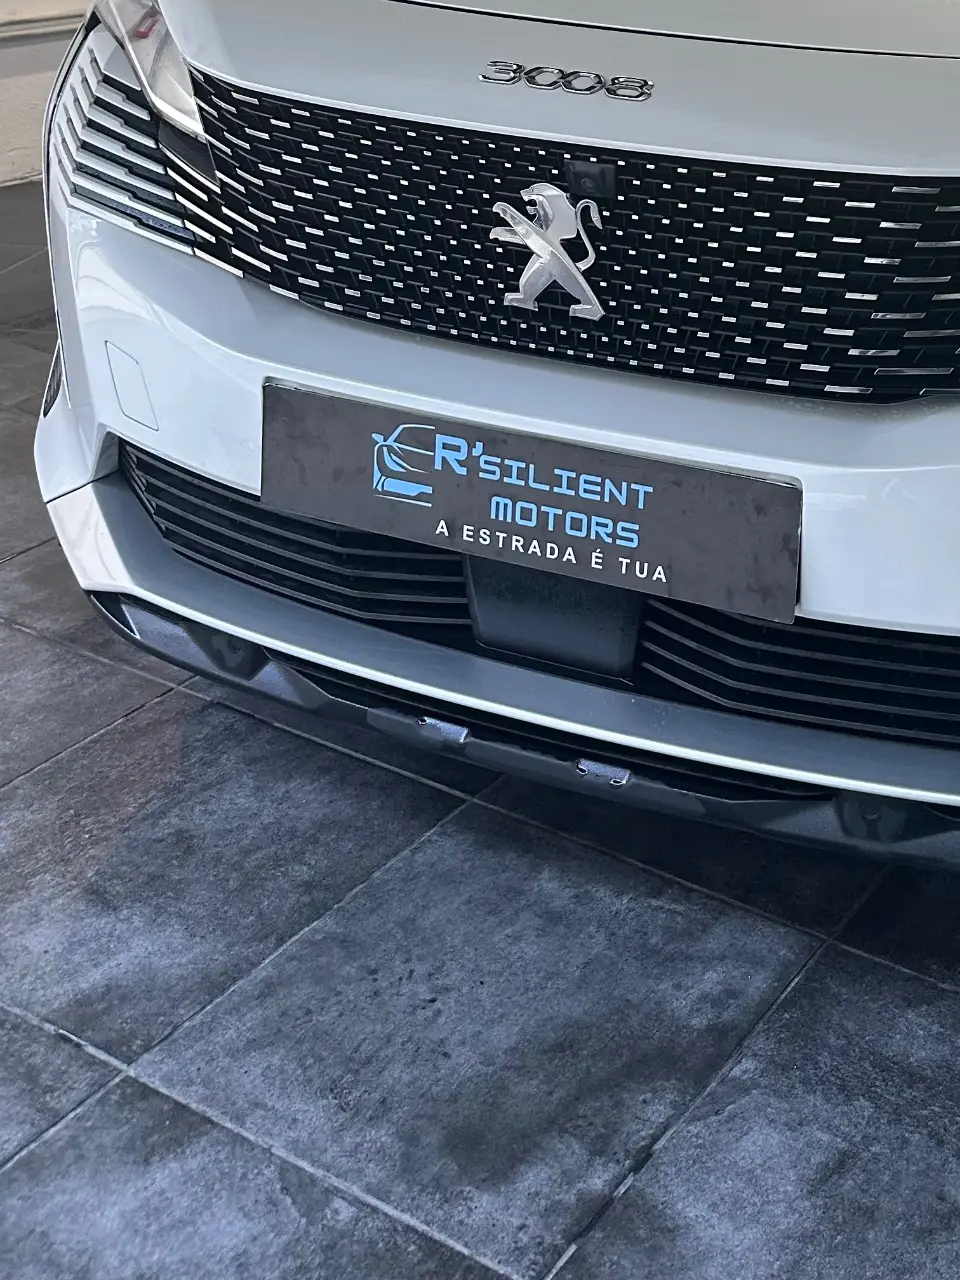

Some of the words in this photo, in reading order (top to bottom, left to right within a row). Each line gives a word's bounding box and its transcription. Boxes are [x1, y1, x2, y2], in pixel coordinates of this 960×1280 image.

[478, 61, 654, 101] 3008
[434, 433, 654, 510] R'SILIENT
[490, 495, 640, 548] MOTORS
[435, 519, 449, 537] A
[462, 524, 577, 564] ESTRADA
[591, 548, 604, 570] É
[619, 557, 667, 583] TUA
